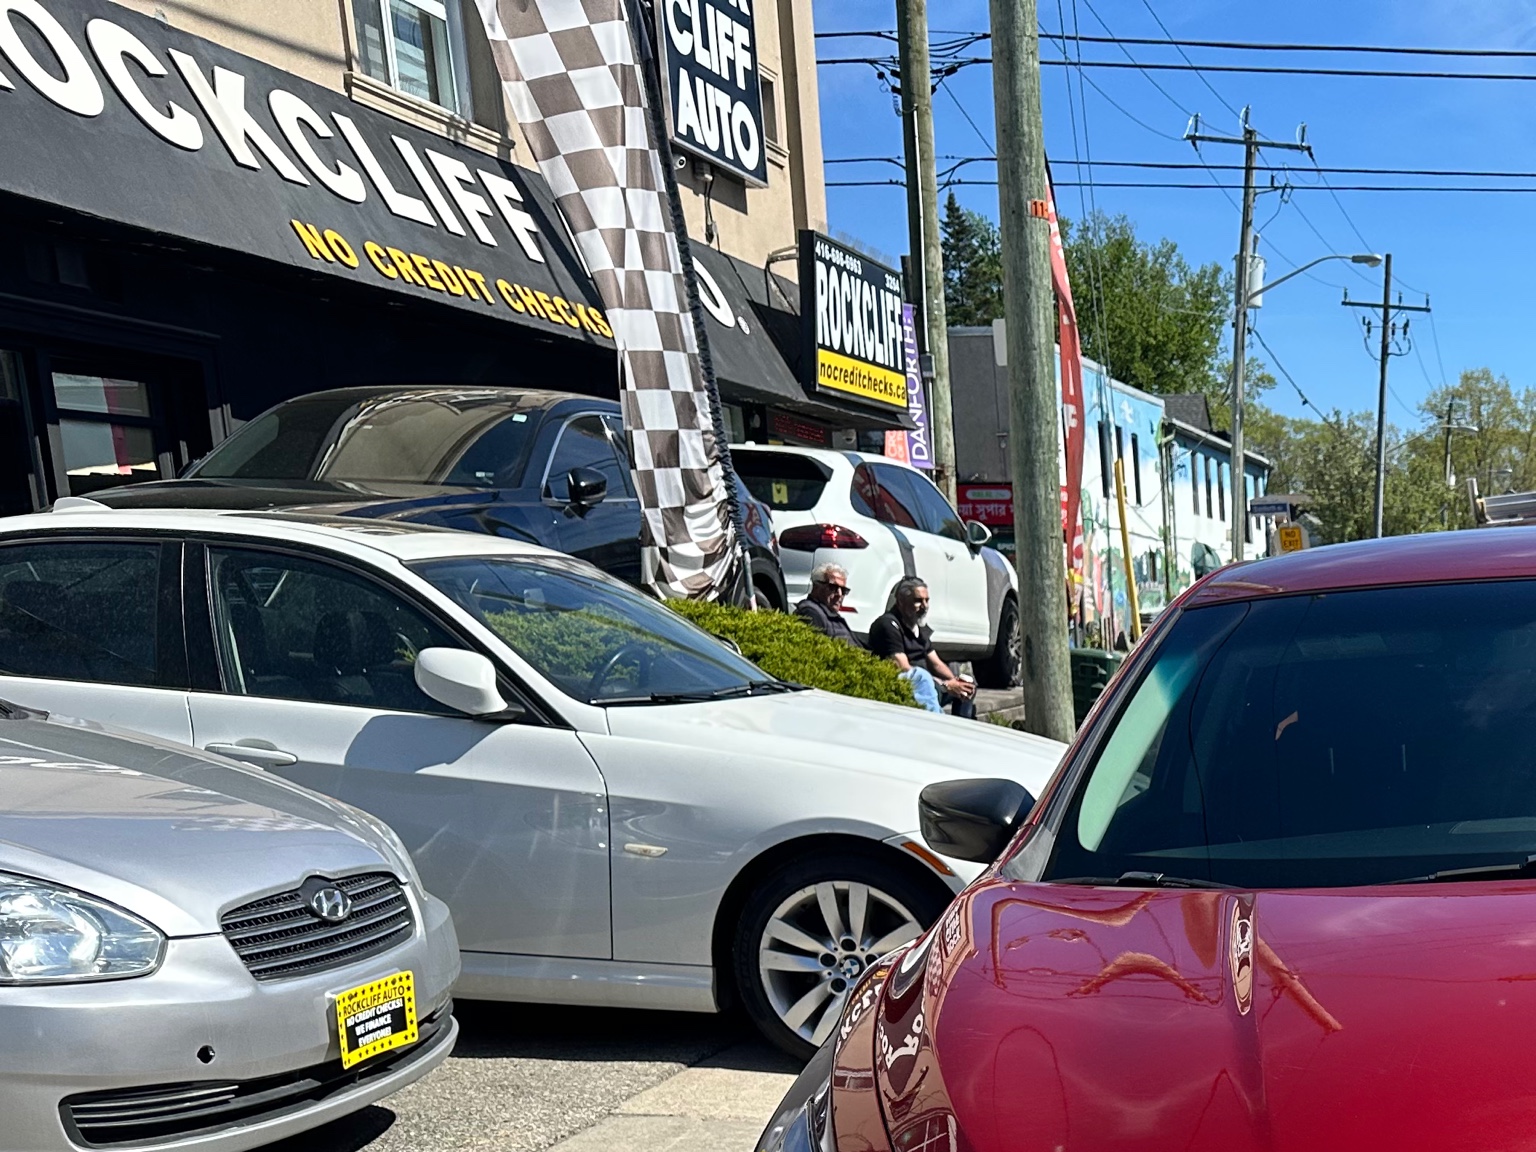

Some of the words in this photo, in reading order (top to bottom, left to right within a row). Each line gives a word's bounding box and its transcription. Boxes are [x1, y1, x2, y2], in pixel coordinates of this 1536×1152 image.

[664, 0, 752, 91] CLIFF
[0, 0, 545, 263] OCKCLIFF
[677, 66, 760, 171] AUTO
[815, 240, 862, 276] 416-686-6963
[290, 218, 359, 269] NO
[363, 240, 495, 304] CREDIT
[495, 278, 614, 339] CHECKS
[816, 260, 904, 371] ROCKCLIFF
[819, 360, 907, 401] nocreditchecks.ca
[1283, 539, 1299, 549] EXIT
[1285, 530, 1296, 538] NO
[343, 991, 381, 1017] ROCKCLIFF
[382, 985, 405, 1000] AUTO
[355, 1008, 376, 1023] CREDIT
[355, 1024, 365, 1036] WE
[365, 1013, 392, 1032] FINANCE
